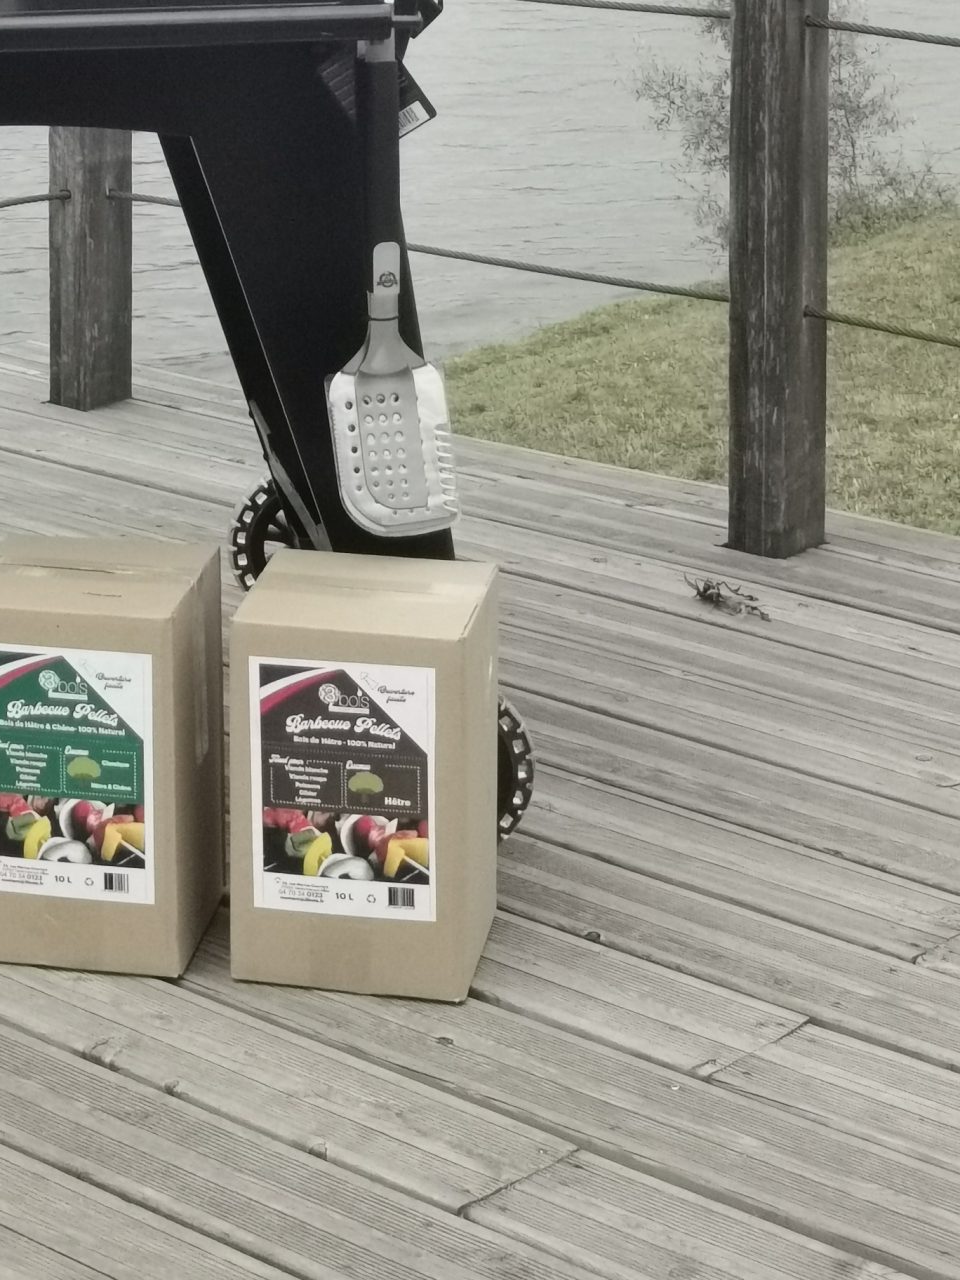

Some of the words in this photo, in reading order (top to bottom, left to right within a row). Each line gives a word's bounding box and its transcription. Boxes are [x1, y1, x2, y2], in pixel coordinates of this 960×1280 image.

[339, 692, 370, 708] bois
[6, 699, 70, 719] Barbecue
[72, 703, 119, 727] Pellets
[285, 713, 351, 733] Barbecue
[353, 717, 401, 740] Pellets
[335, 892, 346, 900] 10
[349, 893, 354, 901] L
